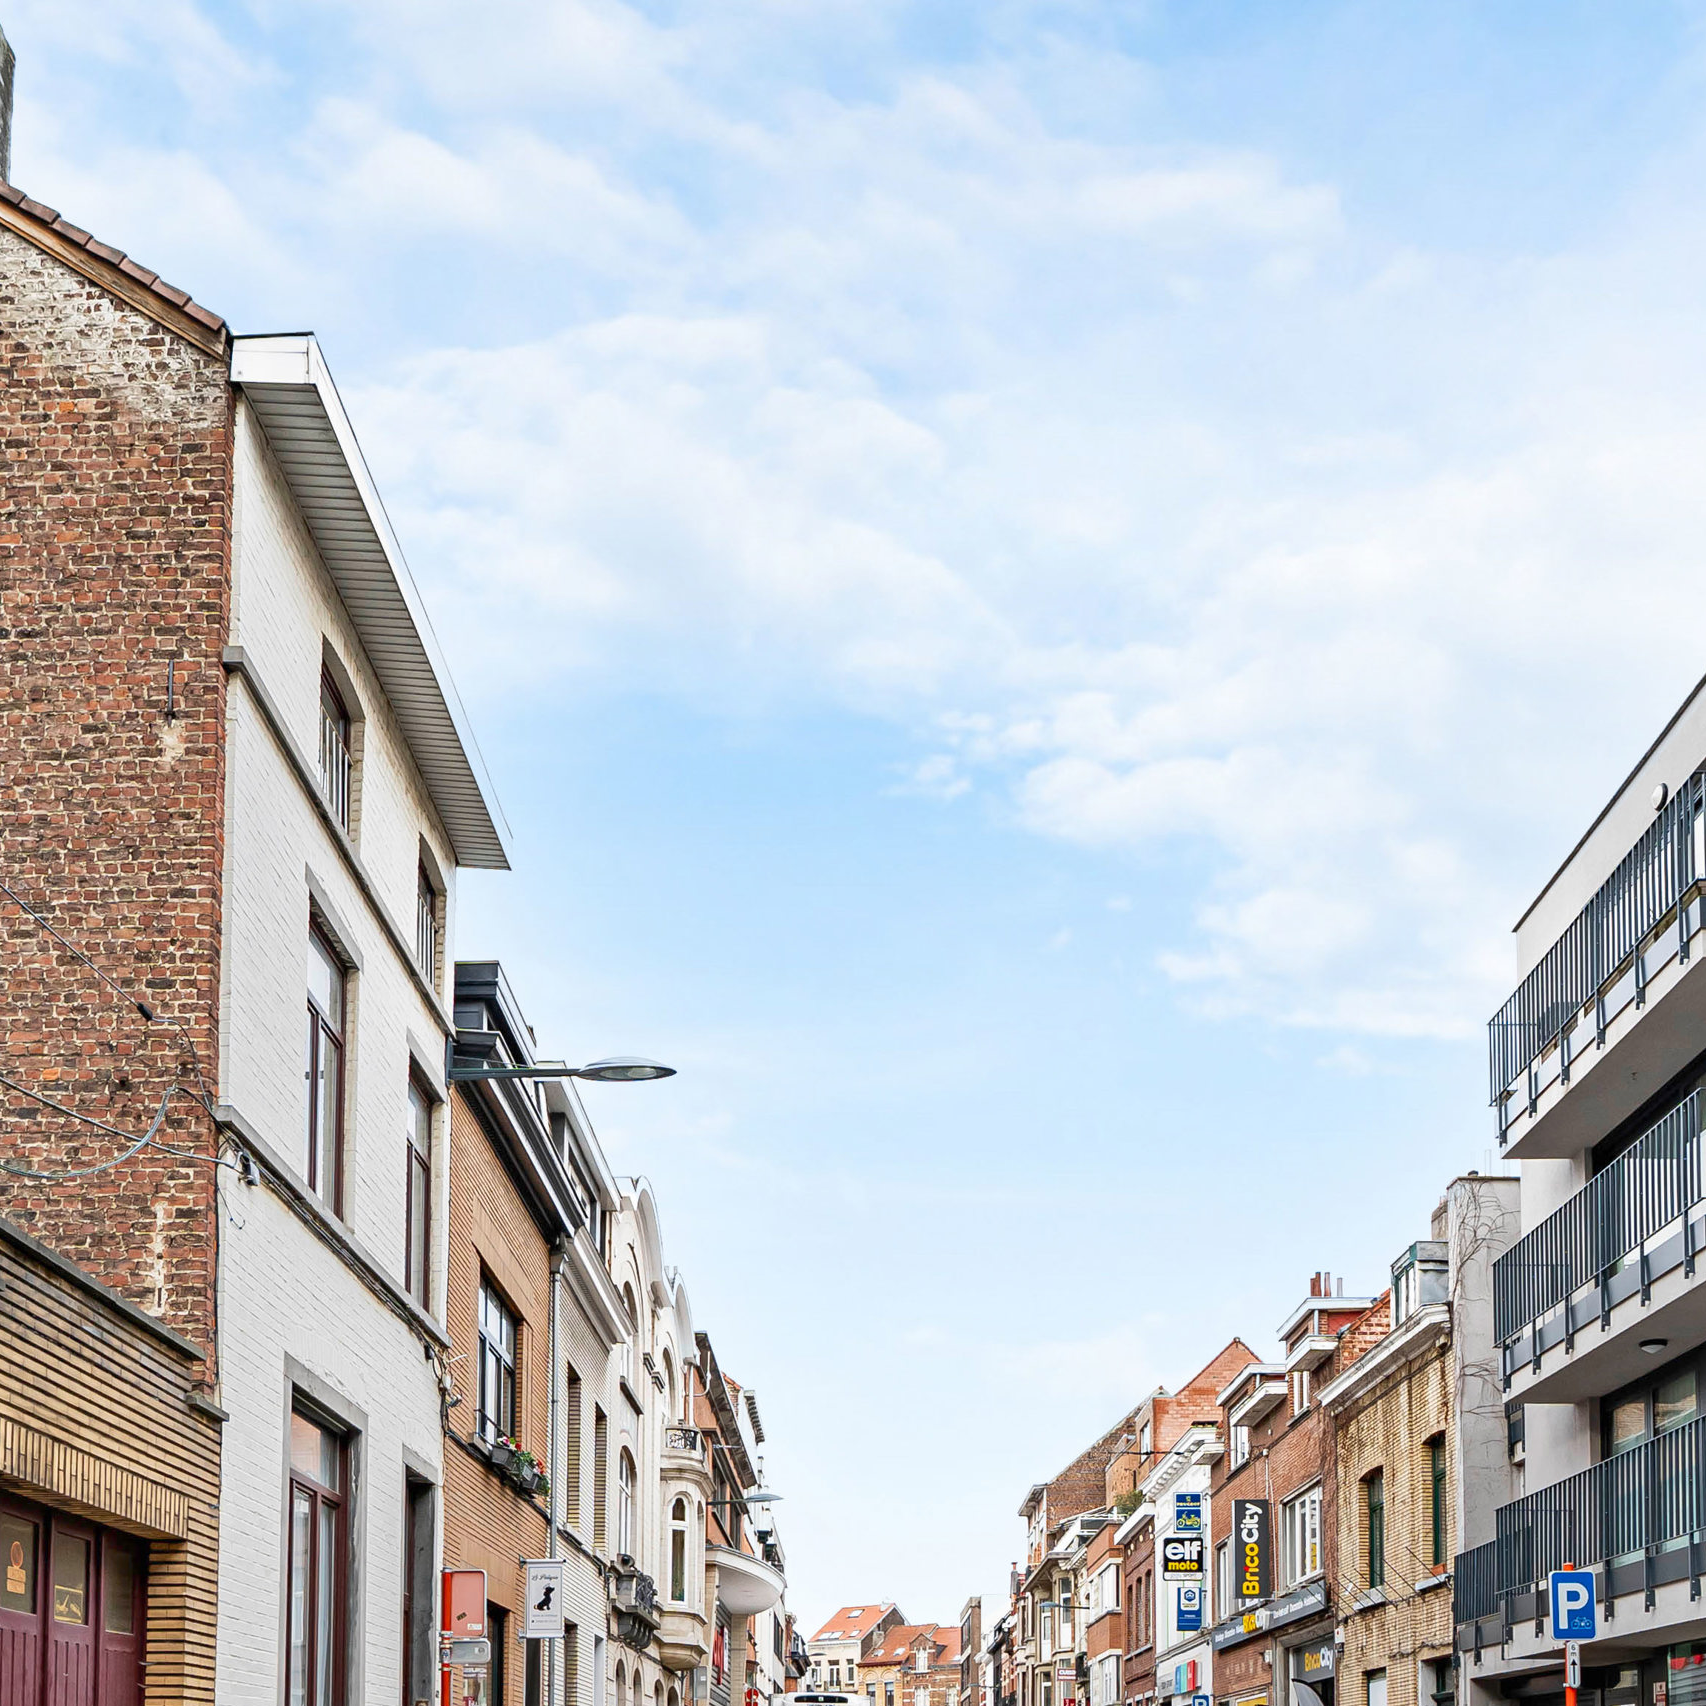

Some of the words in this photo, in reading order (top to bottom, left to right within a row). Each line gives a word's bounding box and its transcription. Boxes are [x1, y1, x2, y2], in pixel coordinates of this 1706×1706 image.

[1165, 1541, 1201, 1560] elf
[1240, 1503, 1263, 1595] BricoCity
[1168, 1561, 1199, 1571] moto
[1557, 1582, 1590, 1630] P
[1304, 1646, 1334, 1672] BricoCity
